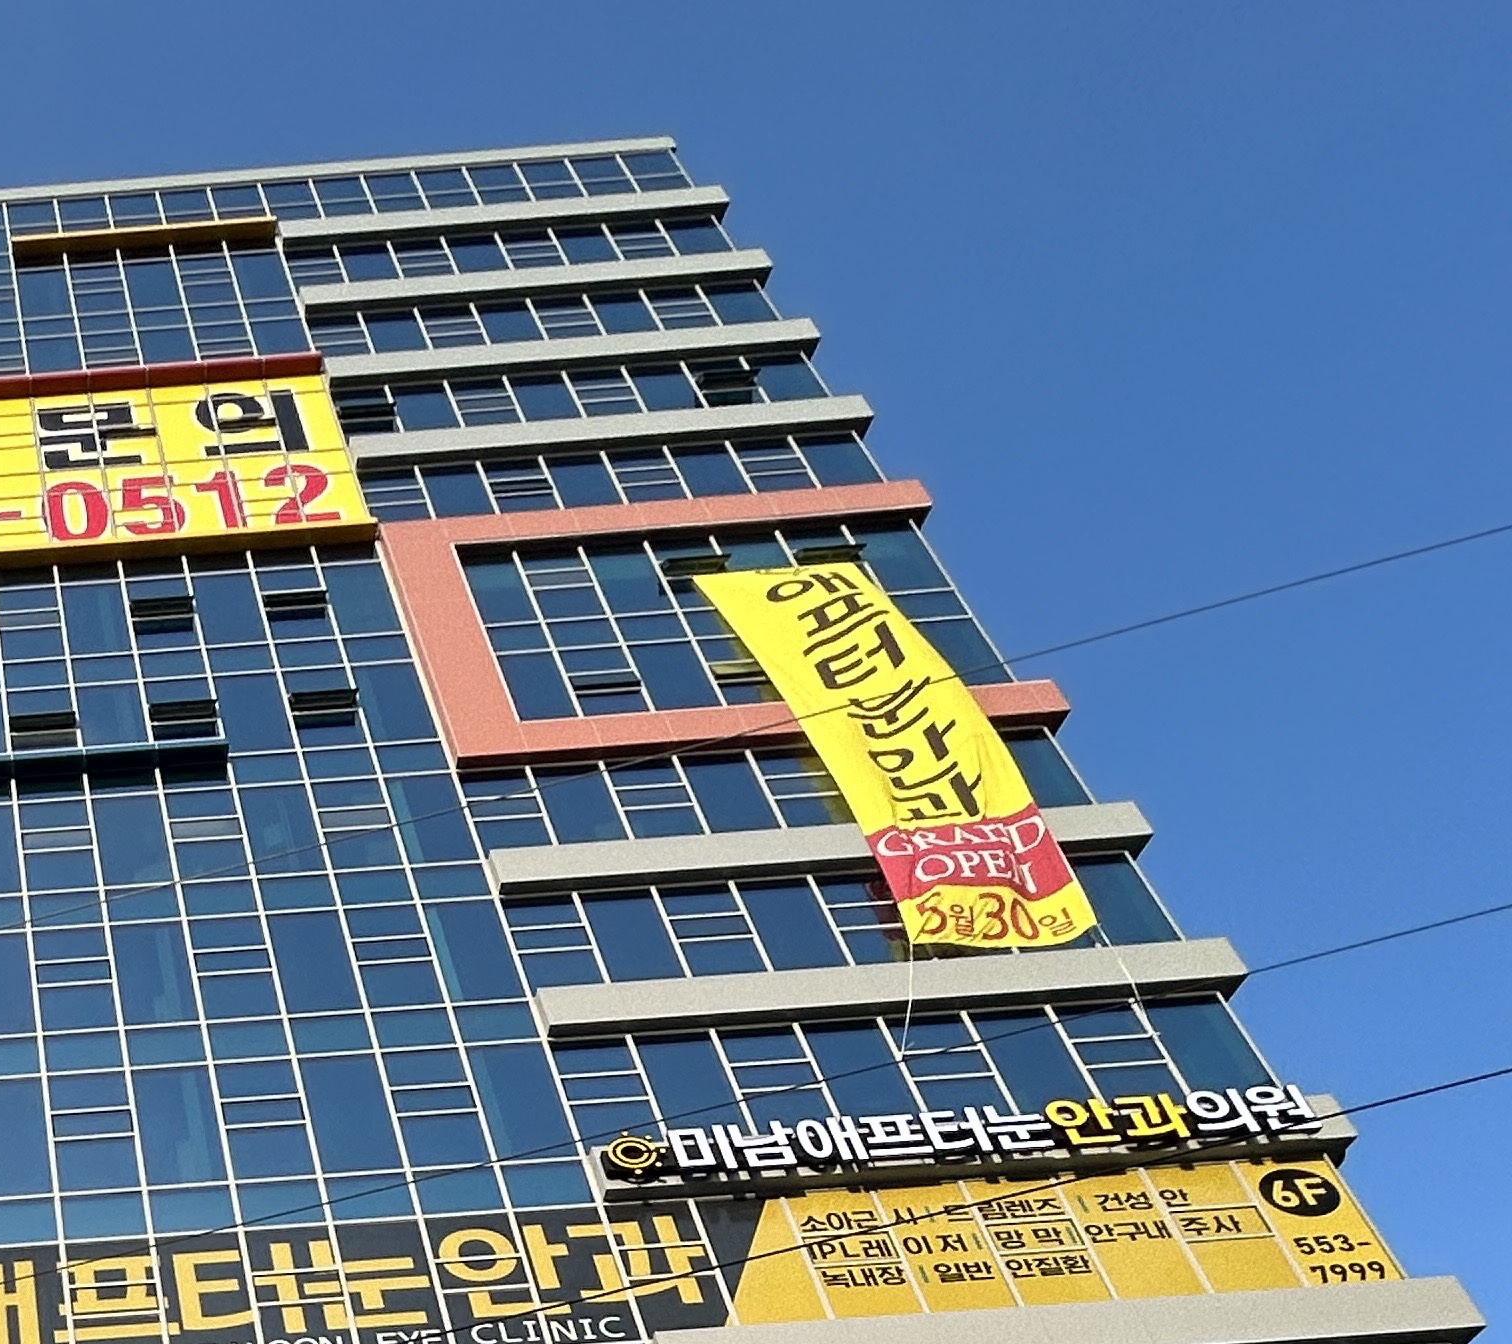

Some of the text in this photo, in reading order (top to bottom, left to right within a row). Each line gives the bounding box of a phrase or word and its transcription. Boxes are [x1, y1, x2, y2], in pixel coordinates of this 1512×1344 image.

[915, 849, 1038, 893] OPEN
[1272, 1177, 1329, 1208] 6F
[1294, 1233, 1371, 1256] 553-
[821, 1266, 906, 1288] 녹내장
[1309, 1261, 1386, 1284] 7999
